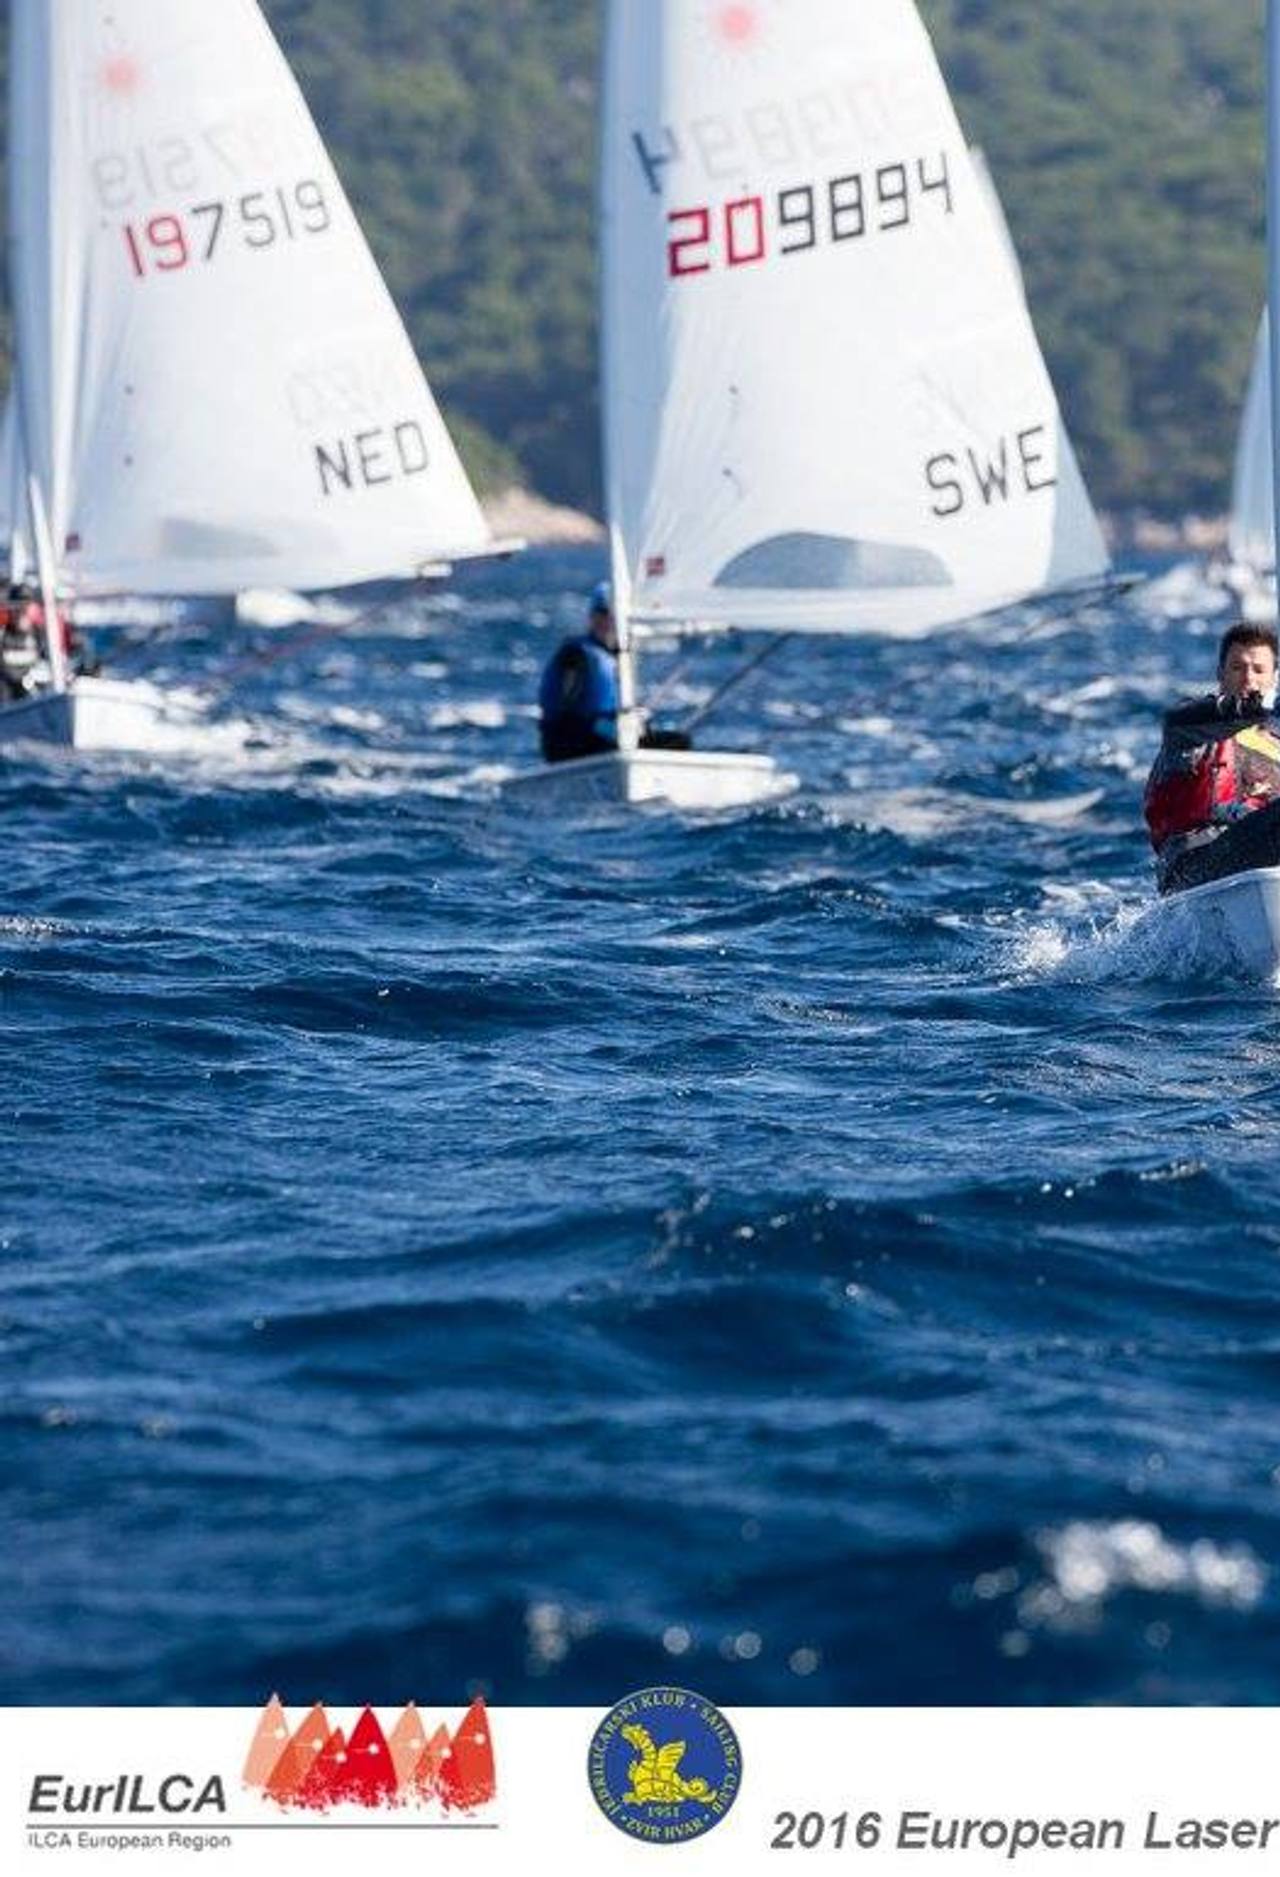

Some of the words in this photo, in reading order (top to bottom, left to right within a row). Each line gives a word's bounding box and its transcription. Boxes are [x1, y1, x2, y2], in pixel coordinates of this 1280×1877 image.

[124, 180, 332, 278] 197519
[666, 151, 955, 278] 209894
[315, 421, 430, 495] NED
[924, 425, 1058, 516] SWE
